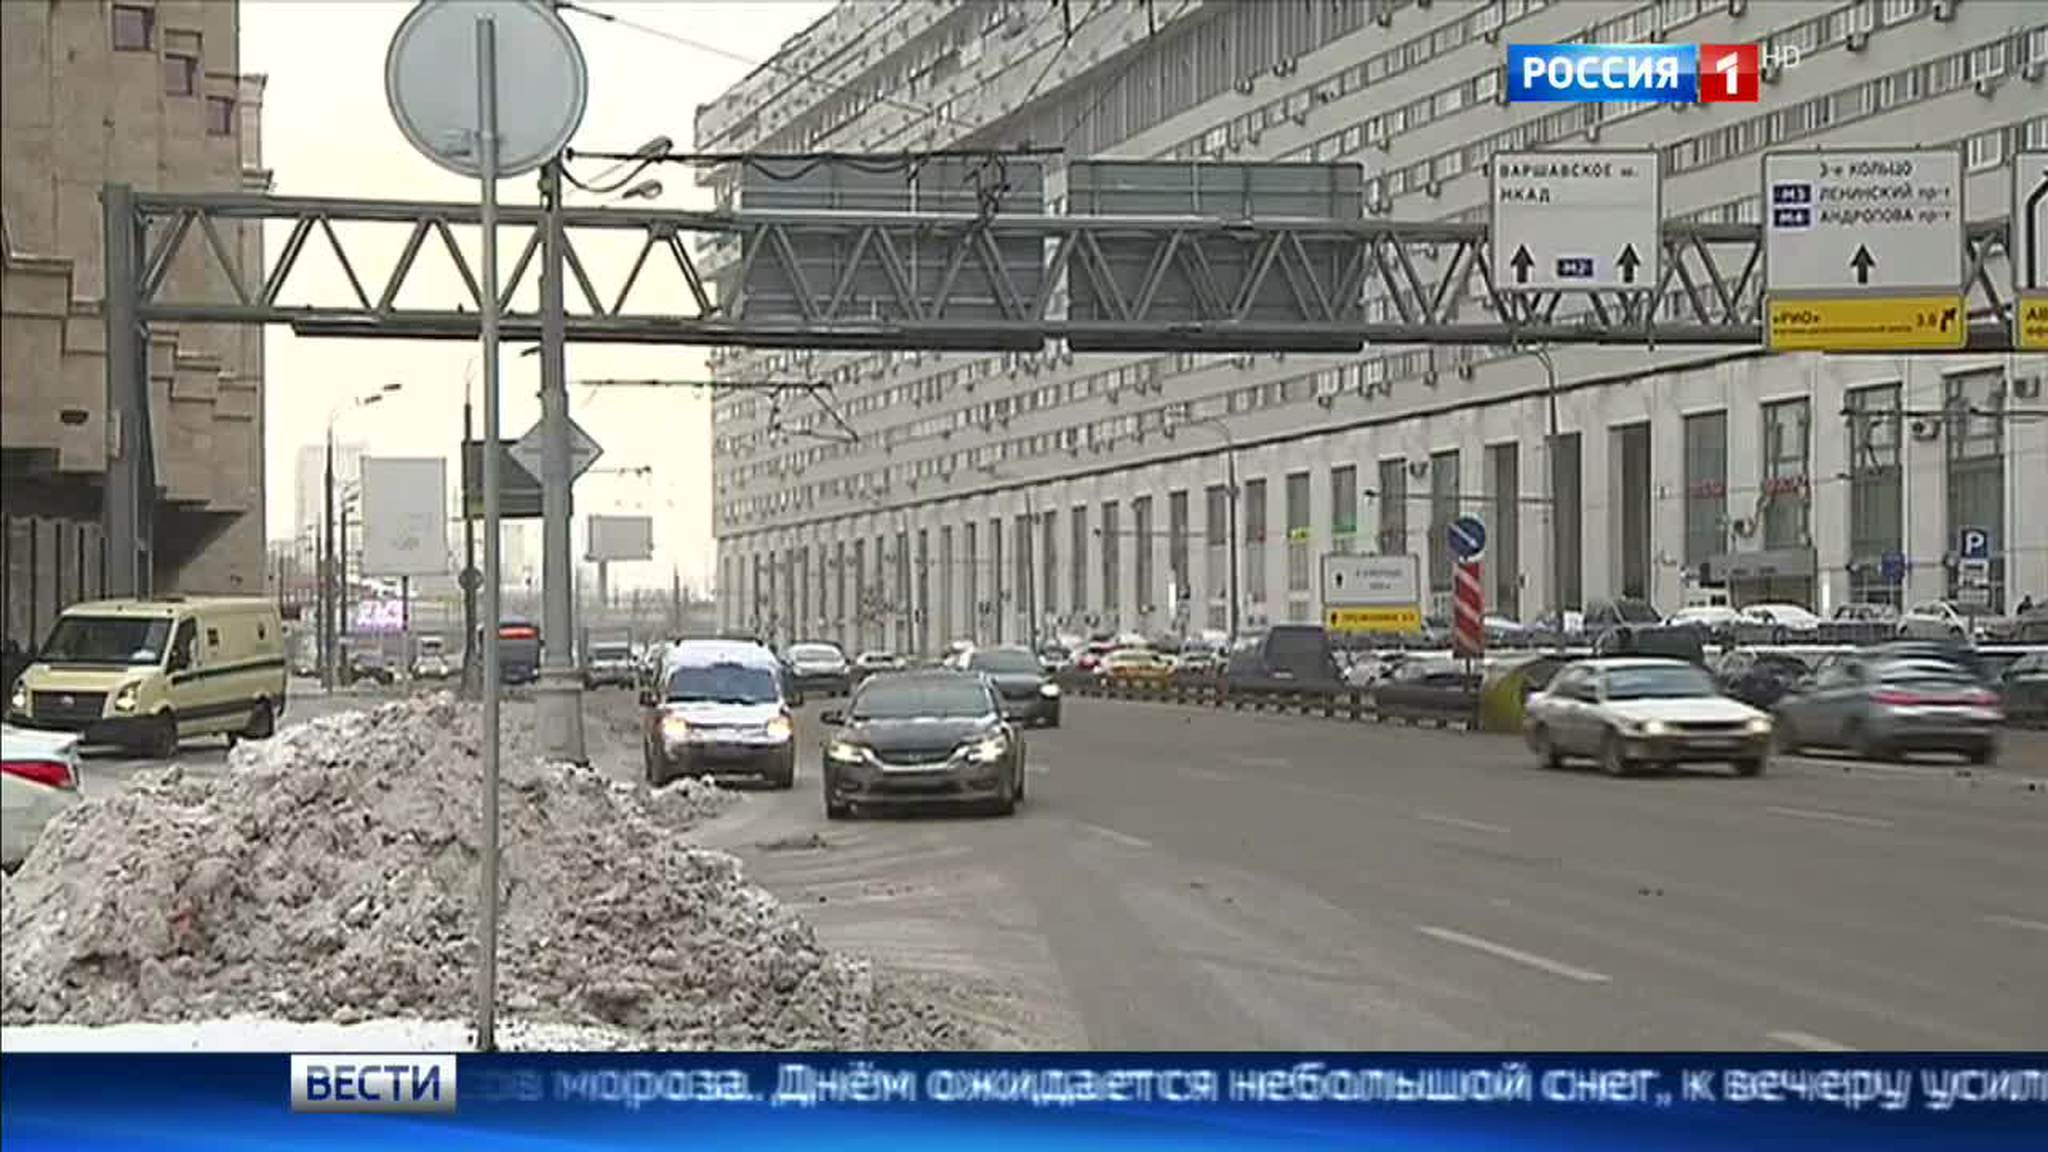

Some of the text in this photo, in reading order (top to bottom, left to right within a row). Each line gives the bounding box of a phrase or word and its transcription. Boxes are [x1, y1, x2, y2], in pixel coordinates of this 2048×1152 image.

[1500, 163, 1612, 178] ВАРШАВСКОЕ
[1850, 160, 1913, 176] КОЛЬЦО
[1819, 183, 1912, 199] ЛЕНИНСКИЙ
[1819, 208, 1913, 224] АНДРОПОВА
